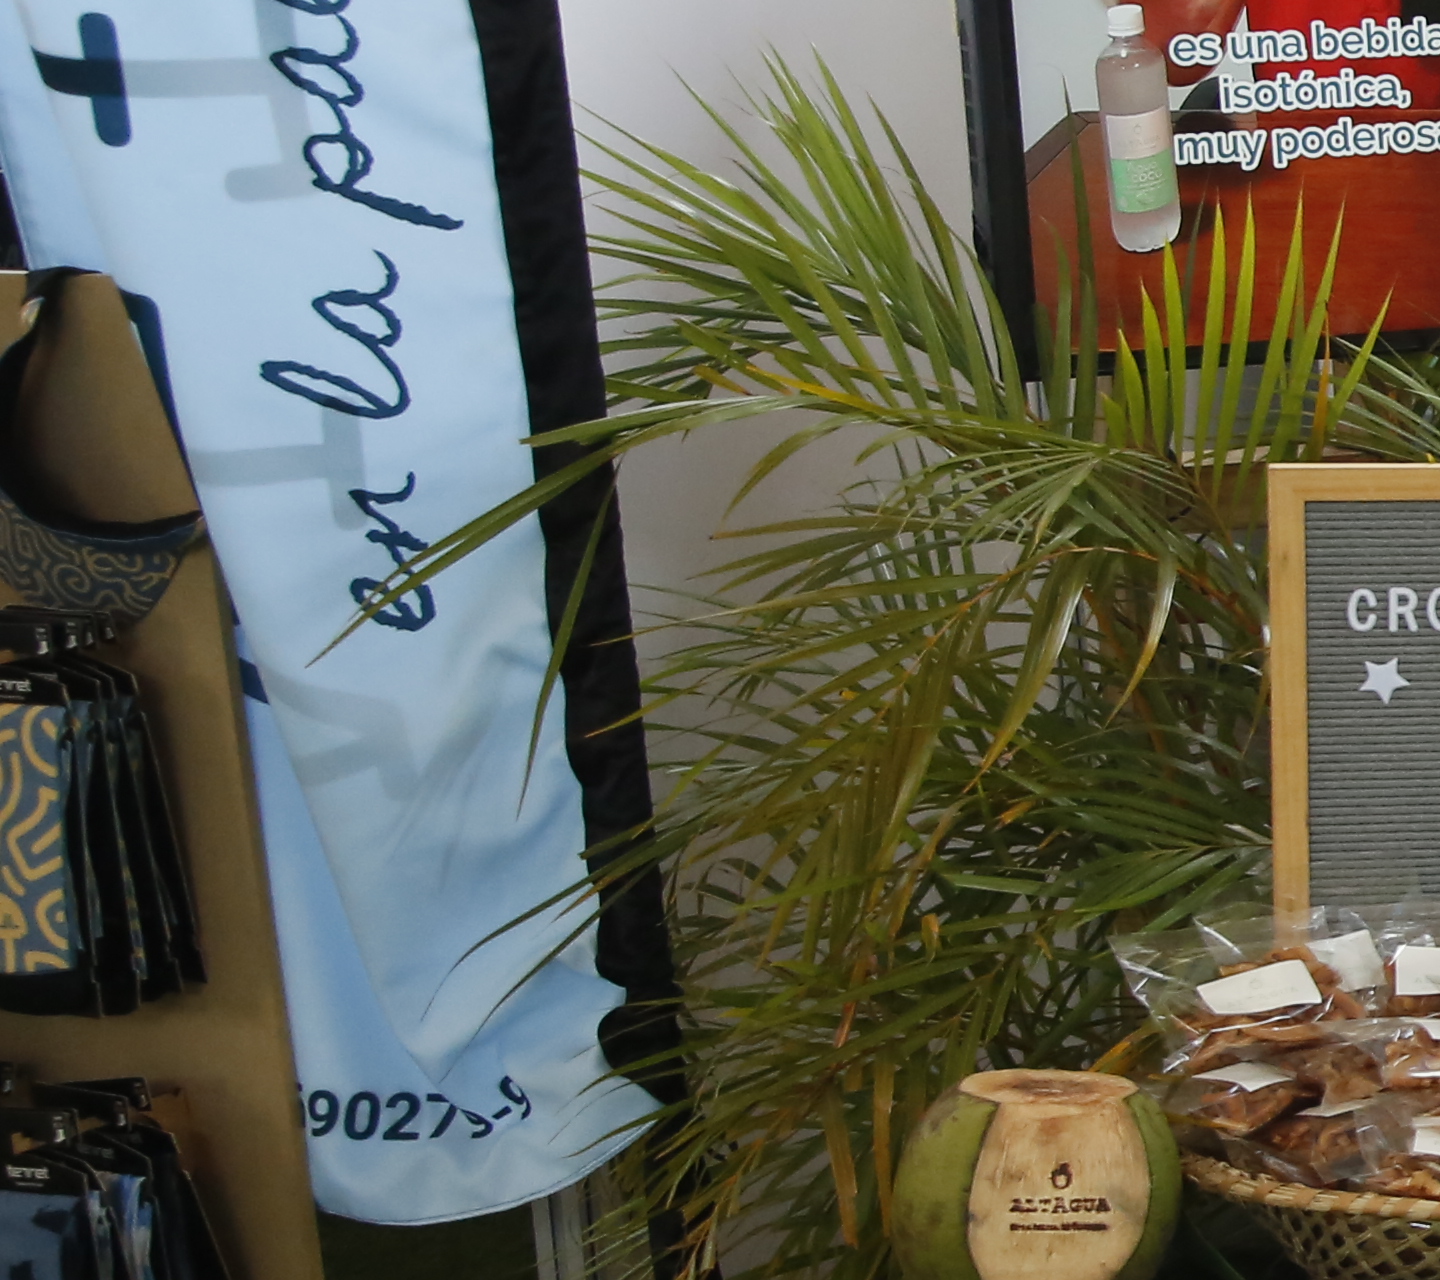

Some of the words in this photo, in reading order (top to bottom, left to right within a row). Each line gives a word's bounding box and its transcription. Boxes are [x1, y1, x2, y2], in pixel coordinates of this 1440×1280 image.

[1171, 33, 1221, 65] es
[1230, 29, 1305, 61] una
[1221, 70, 1411, 111] isotónica,
[1176, 131, 1265, 169] muy
[260, 250, 410, 419] la
[349, 471, 436, 631] en
